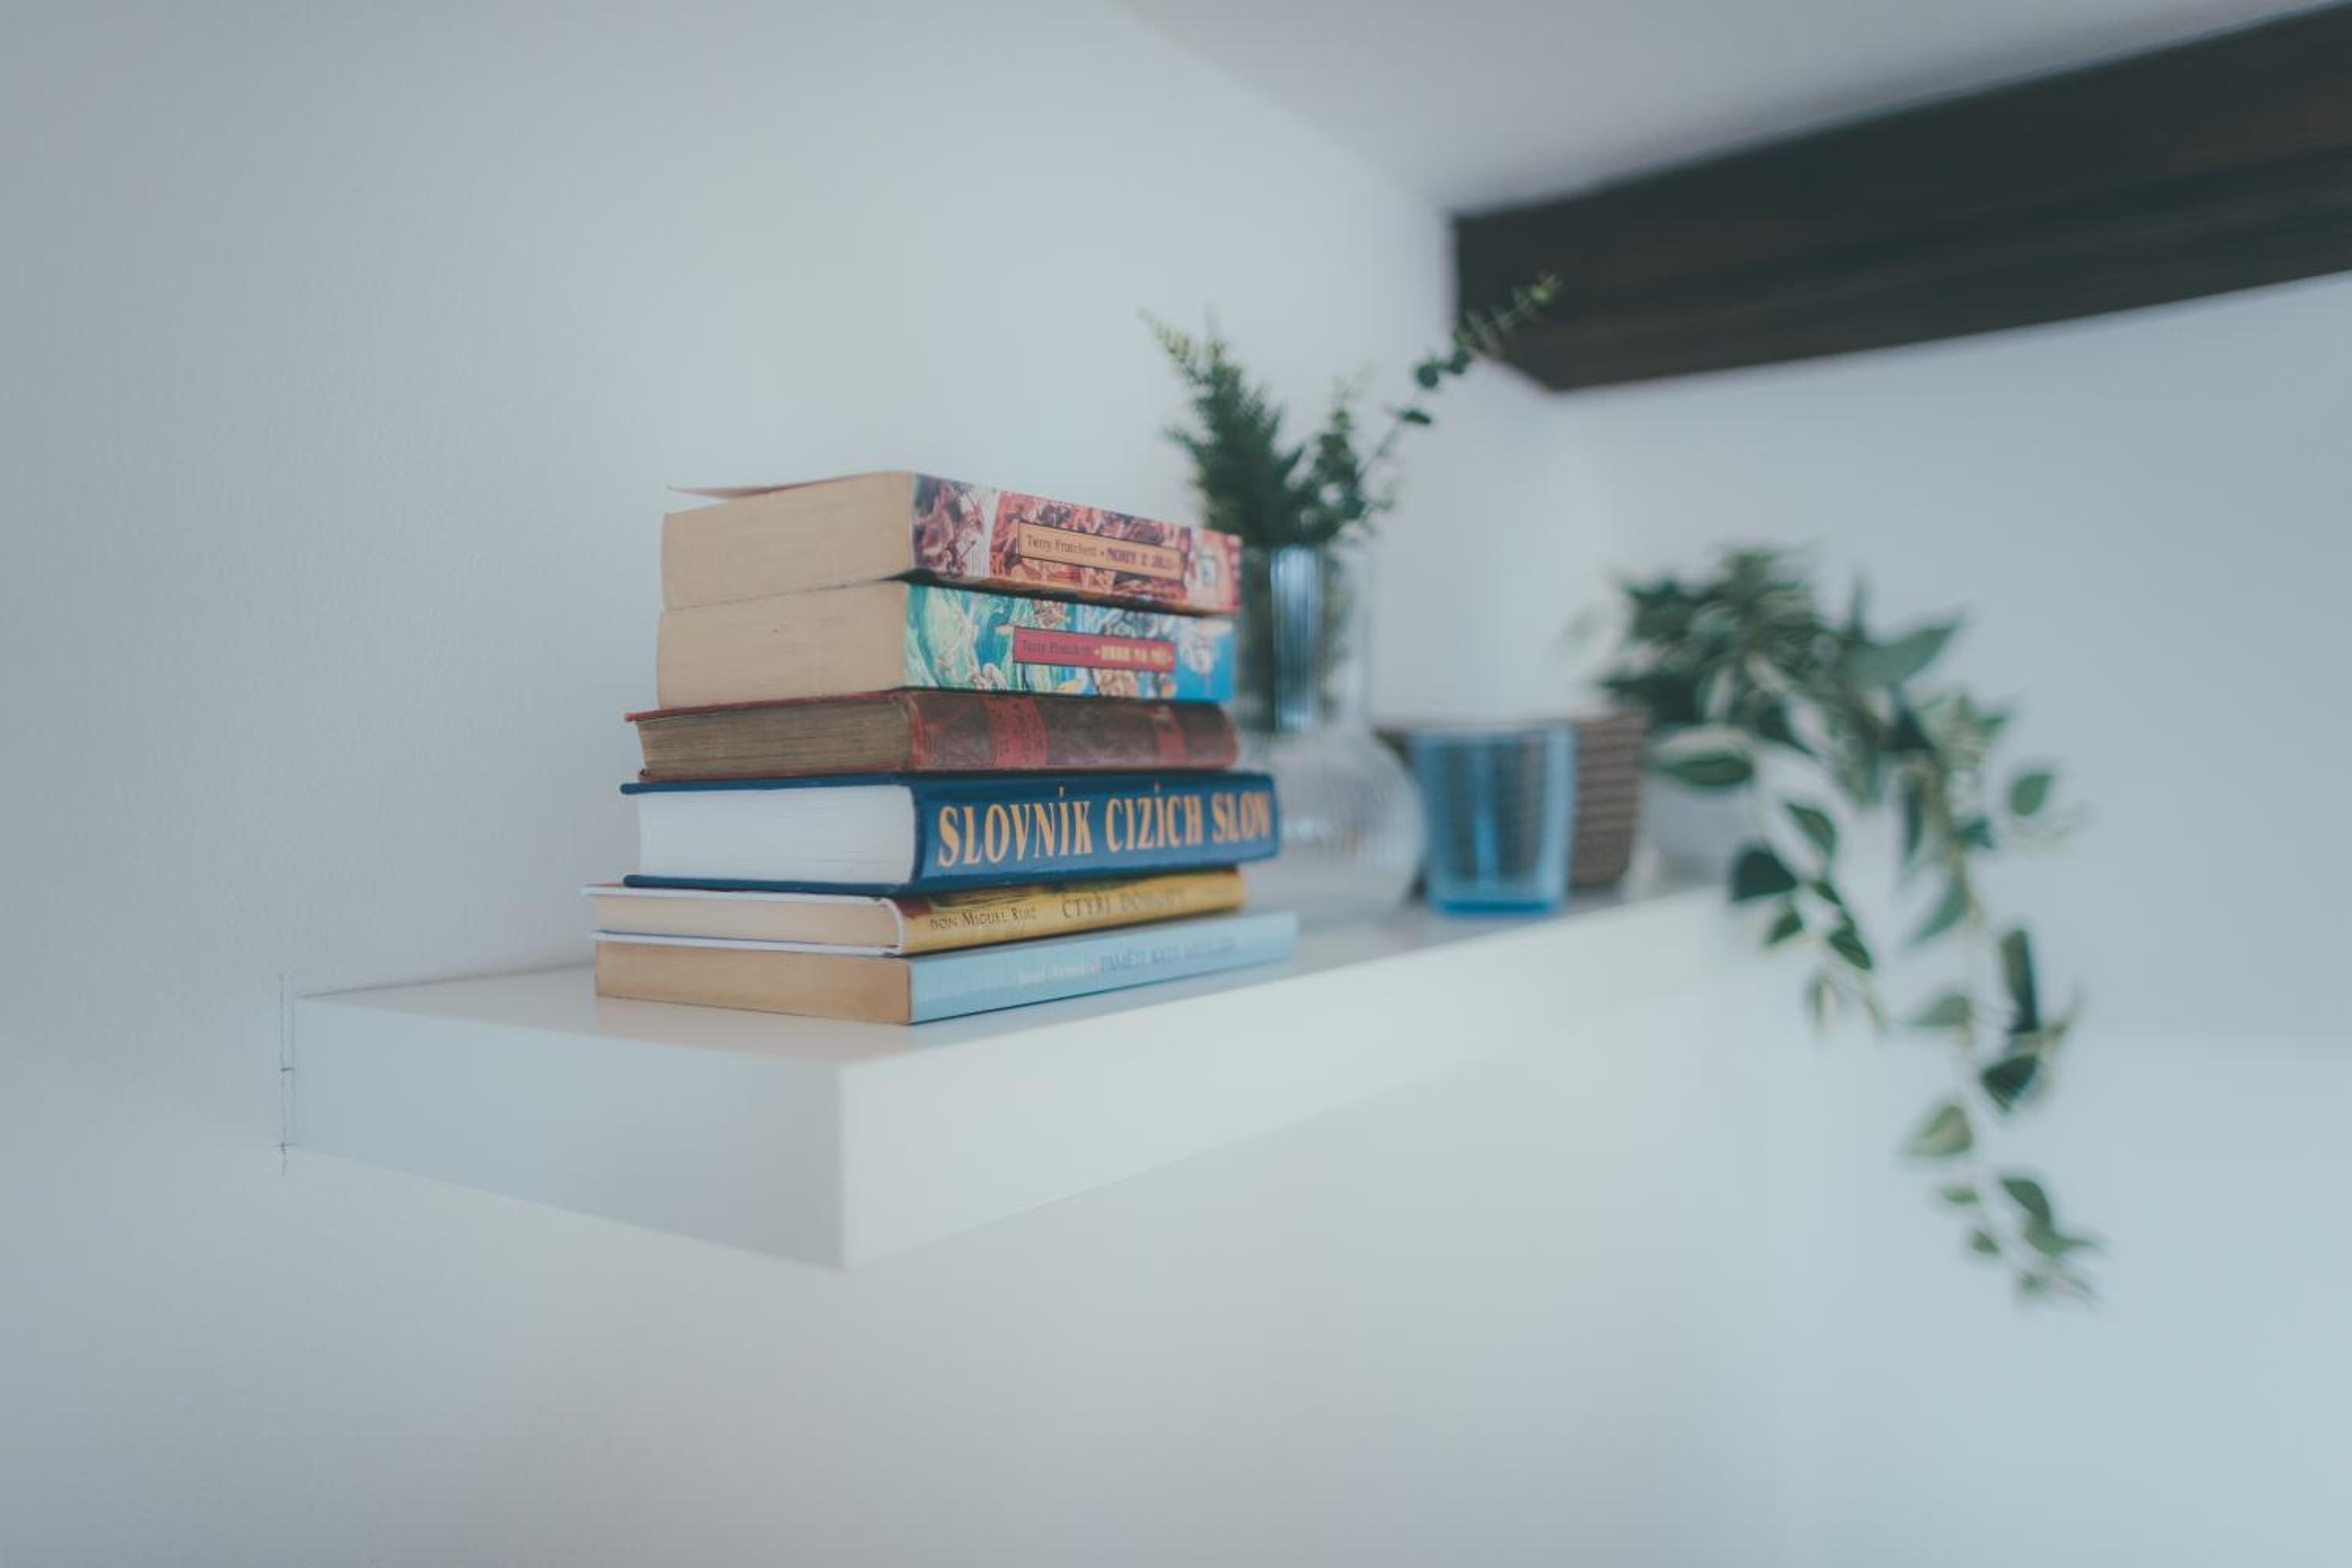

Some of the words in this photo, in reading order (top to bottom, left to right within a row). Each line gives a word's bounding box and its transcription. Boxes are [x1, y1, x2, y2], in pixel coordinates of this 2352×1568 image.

[1027, 534, 1052, 552] Terry
[938, 786, 1093, 867] SLOVNÍK
[1105, 782, 1203, 852] CIZÍCH
